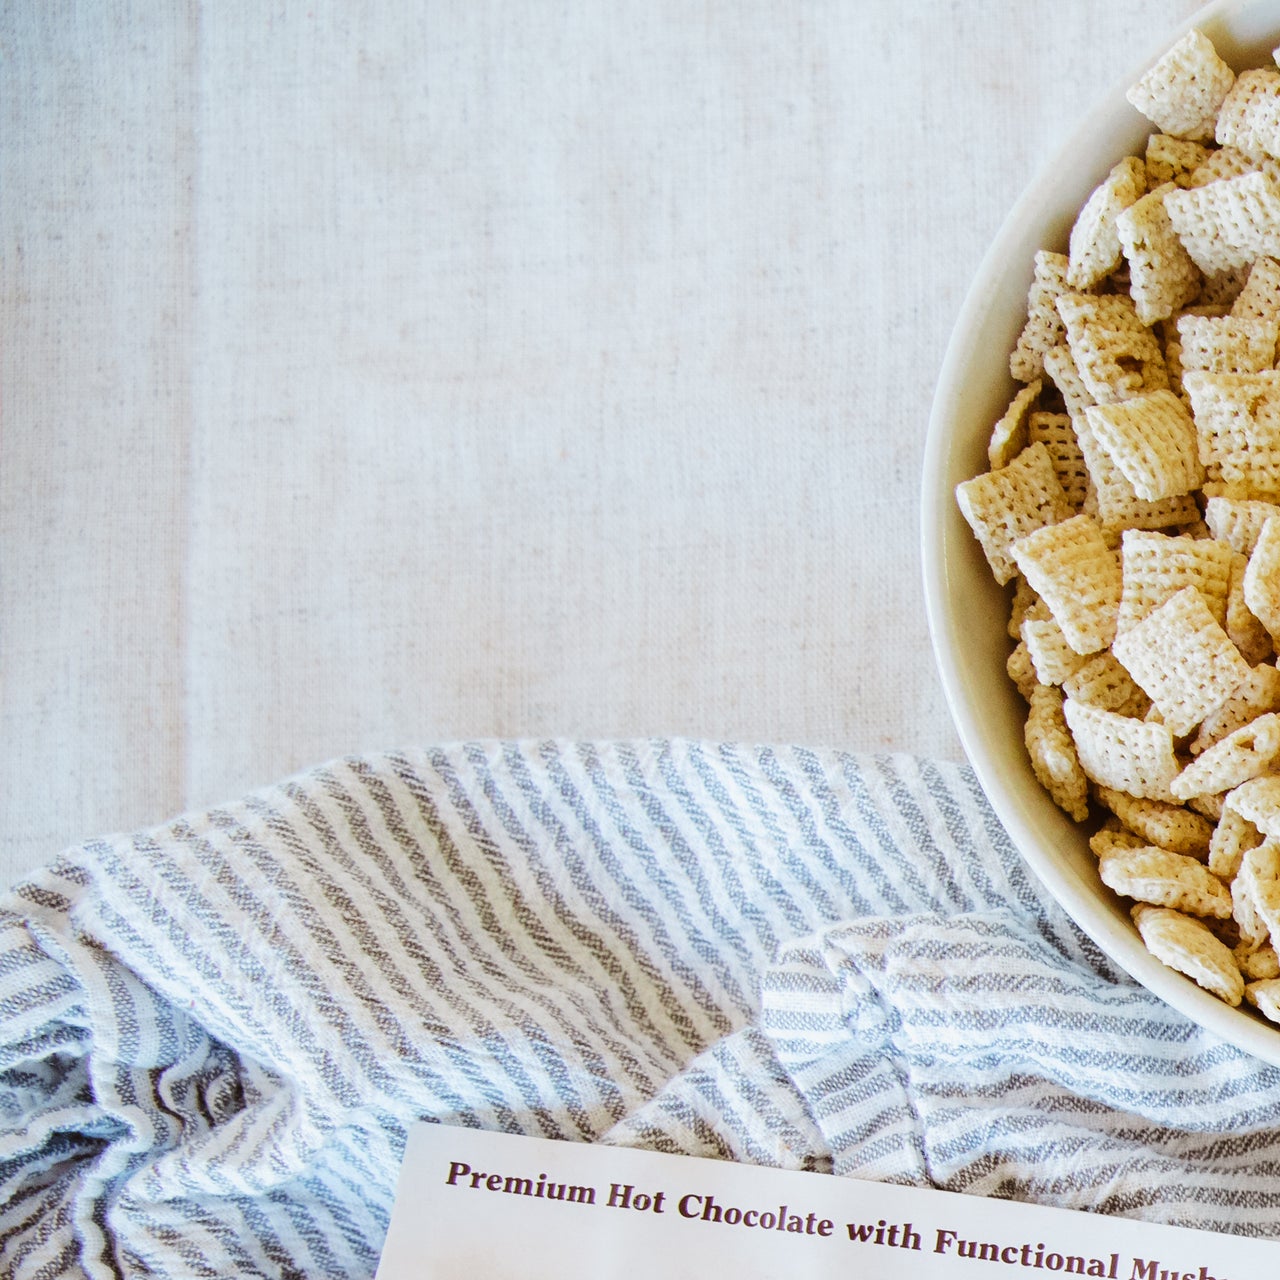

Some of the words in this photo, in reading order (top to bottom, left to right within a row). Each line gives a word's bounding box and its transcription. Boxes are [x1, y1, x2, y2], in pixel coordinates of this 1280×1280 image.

[445, 1161, 596, 1205] Premium
[606, 1183, 665, 1214] Hot
[678, 1193, 834, 1237] Chocolate
[846, 1219, 922, 1251] with
[933, 1228, 1120, 1279] Functional
